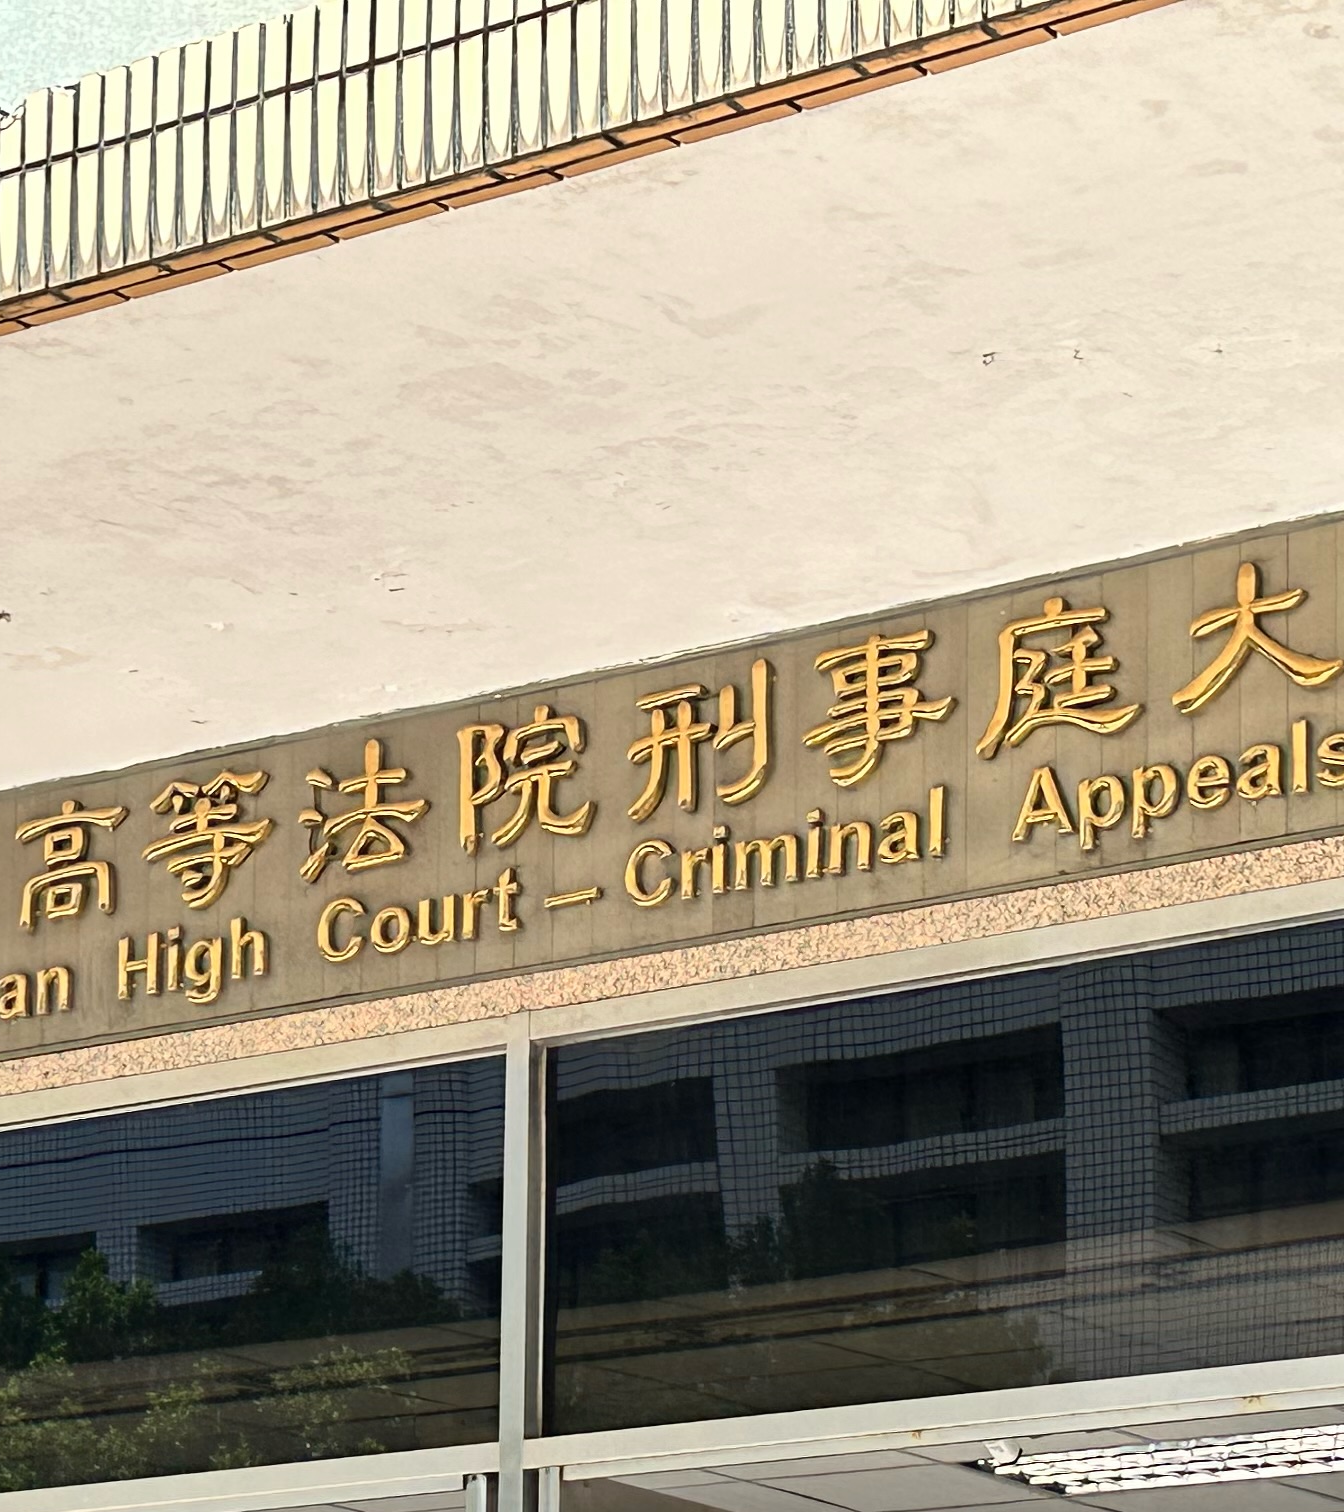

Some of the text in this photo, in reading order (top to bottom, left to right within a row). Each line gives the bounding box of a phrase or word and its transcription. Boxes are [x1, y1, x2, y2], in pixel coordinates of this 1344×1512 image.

[115, 916, 270, 1004] High
[316, 866, 521, 963] Court
[623, 784, 948, 908] Criminal
